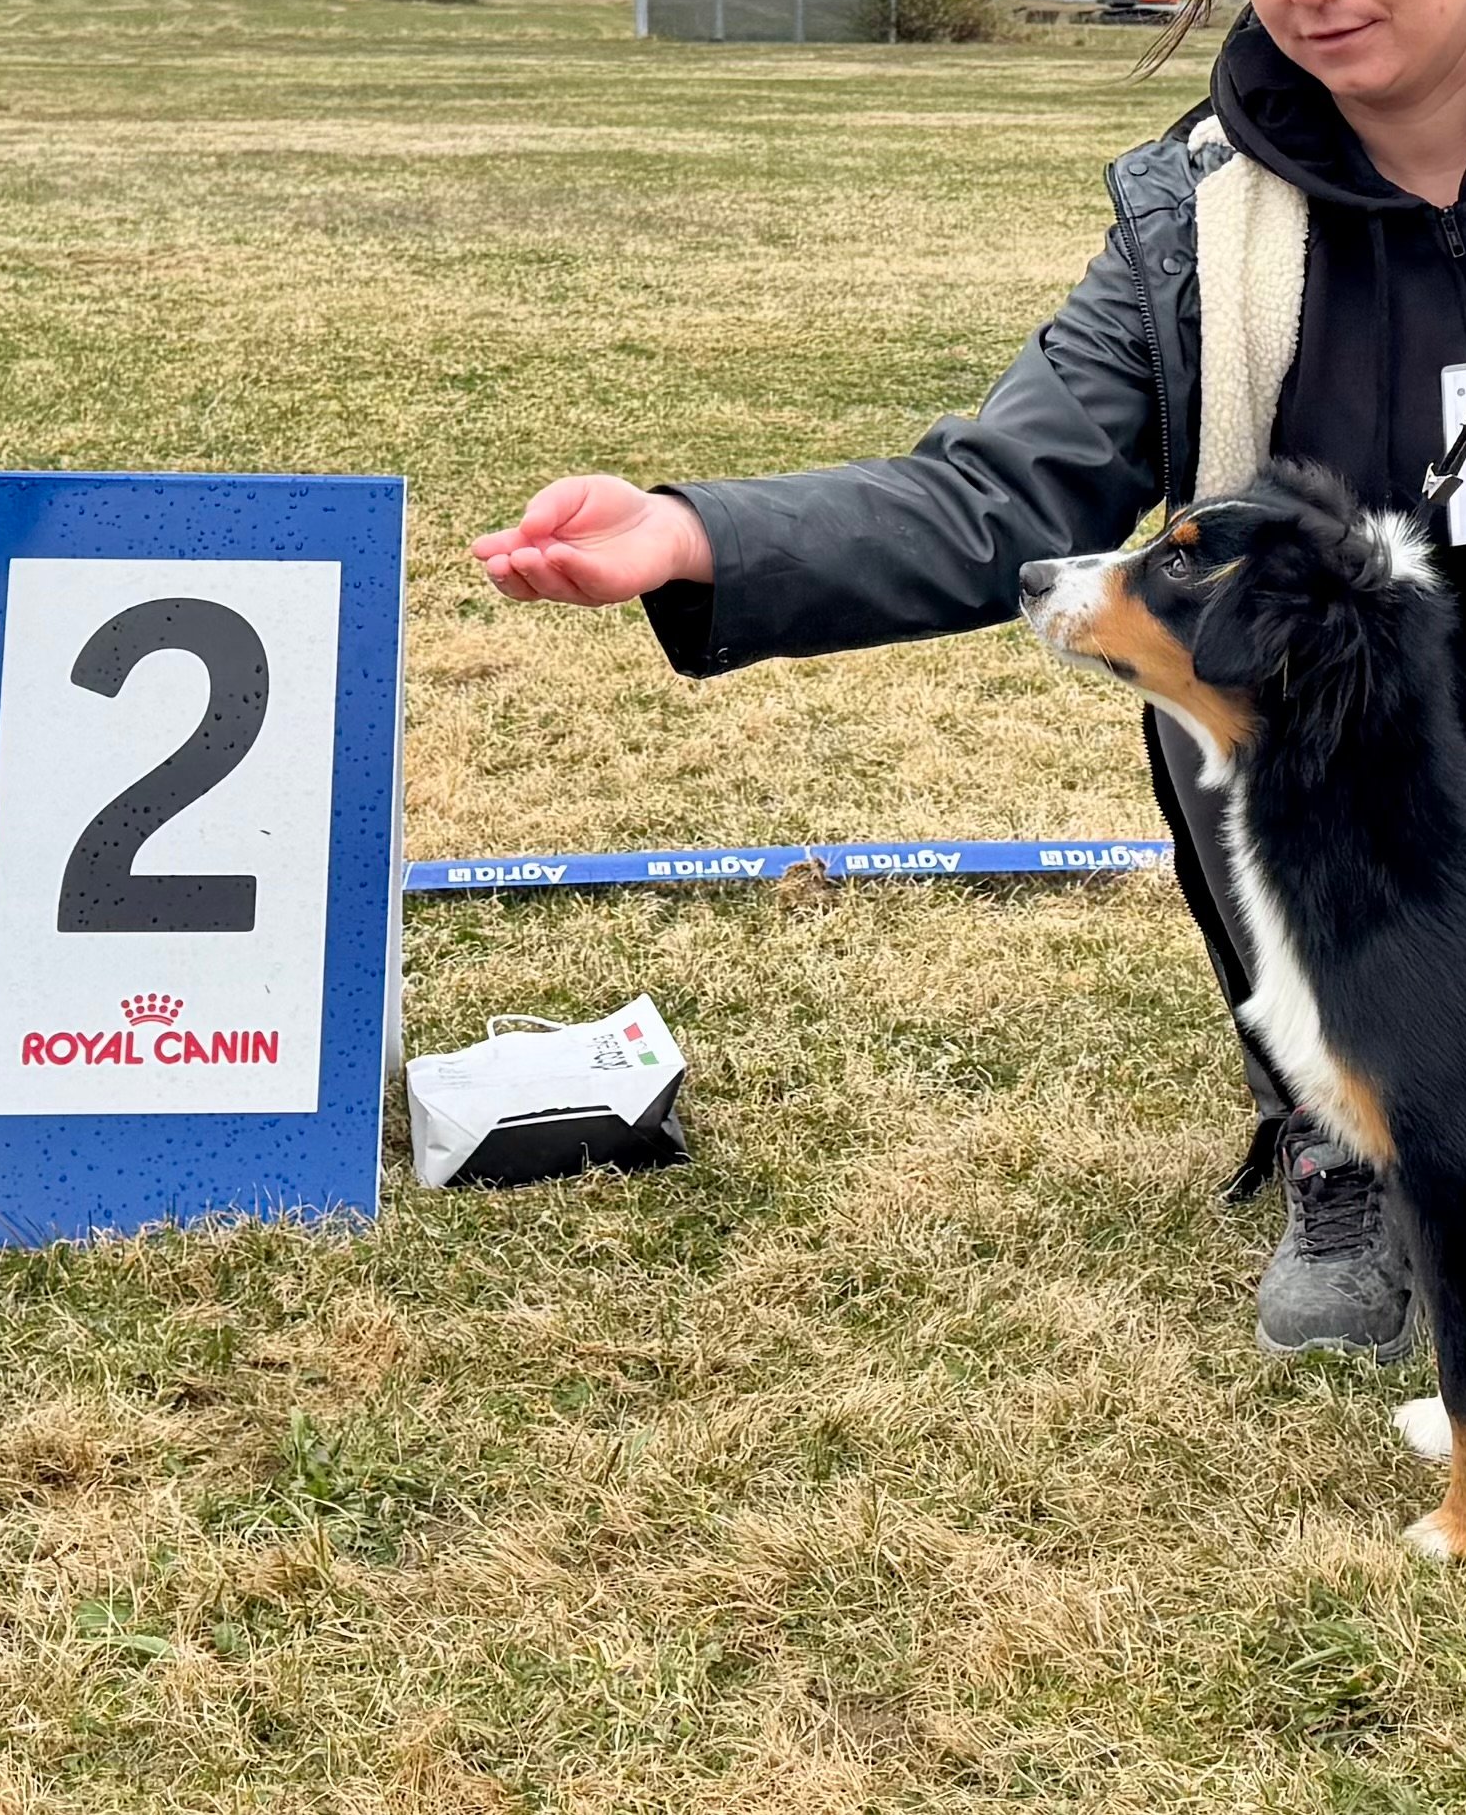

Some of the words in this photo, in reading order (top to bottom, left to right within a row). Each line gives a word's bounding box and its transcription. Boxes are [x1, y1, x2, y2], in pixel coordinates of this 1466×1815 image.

[57, 597, 270, 933] 2
[673, 855, 767, 878] Agria
[871, 849, 962, 873] Agria
[474, 862, 569, 886] Agria
[22, 1032, 144, 1066] ROYAL
[154, 1031, 279, 1065] CANIN
